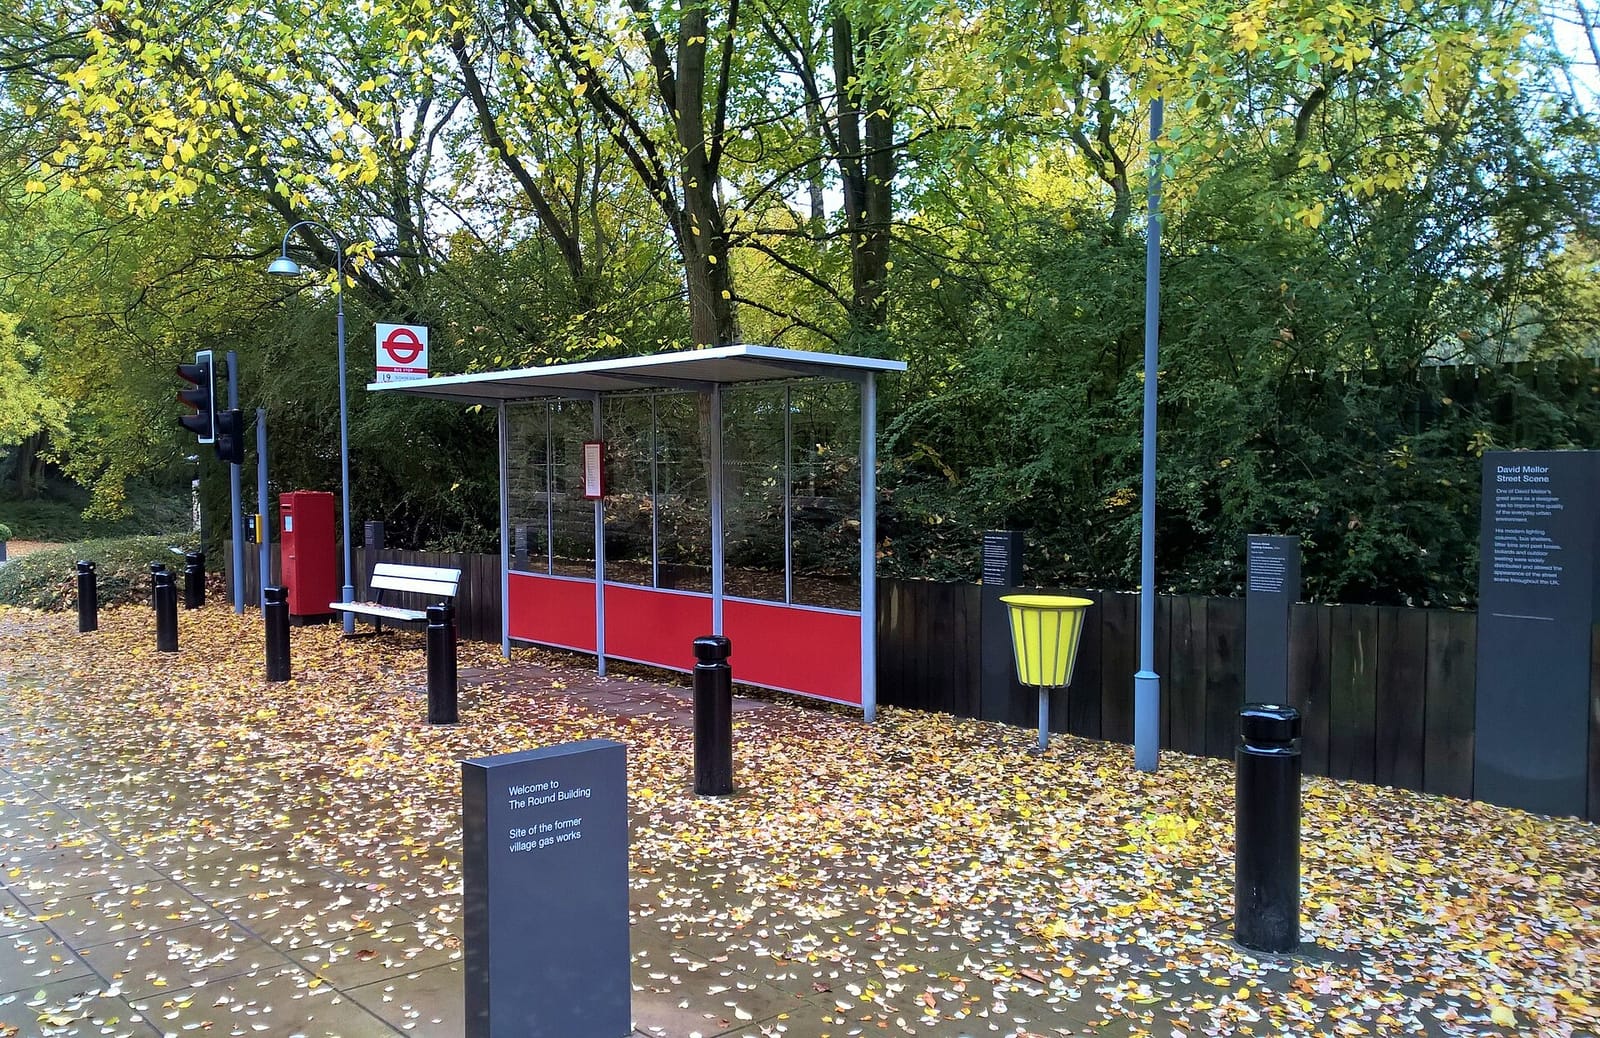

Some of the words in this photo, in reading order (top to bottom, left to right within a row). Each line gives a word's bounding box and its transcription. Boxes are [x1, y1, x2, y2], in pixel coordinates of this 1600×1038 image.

[508, 782, 549, 796] Welcome
[550, 780, 559, 789] to
[508, 799, 526, 810] The
[528, 793, 556, 806] Round
[558, 788, 590, 800] Building
[509, 828, 526, 839] Site
[528, 825, 537, 835] of
[540, 823, 552, 832] the
[554, 818, 582, 830] former
[509, 840, 537, 852] village
[538, 836, 554, 848] gas
[556, 831, 581, 842] works
